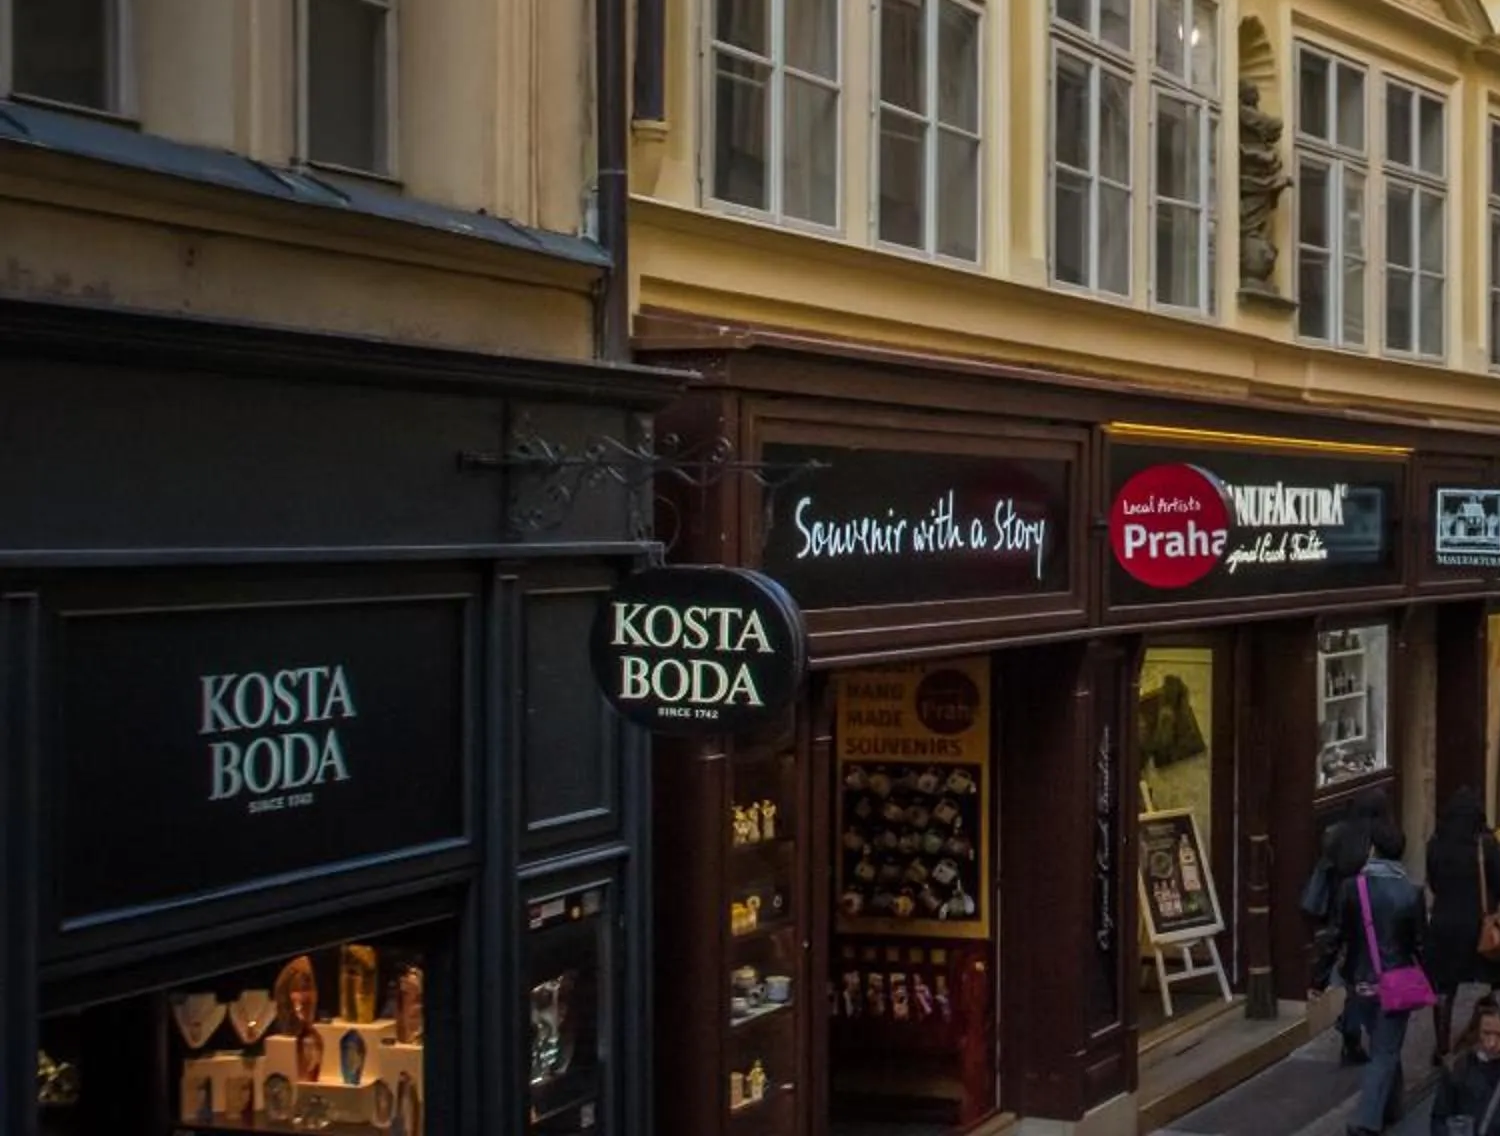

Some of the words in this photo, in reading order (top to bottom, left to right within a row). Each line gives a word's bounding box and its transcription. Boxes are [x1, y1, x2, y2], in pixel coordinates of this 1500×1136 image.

[1122, 495, 1155, 515] Local
[1157, 496, 1201, 514] Artists
[796, 496, 906, 558] Souvenir
[913, 490, 964, 552] with
[970, 517, 988, 549] a
[993, 498, 1045, 580] Story
[1123, 519, 1228, 559] Praha
[611, 602, 775, 654] KOSTA
[199, 664, 357, 735] KOSTA
[618, 655, 765, 707] BODA
[657, 707, 691, 717] SINCE
[695, 709, 719, 719] 1742
[847, 710, 903, 729] MADE
[208, 728, 351, 801] BODA
[845, 737, 963, 756] SOUVENIRS
